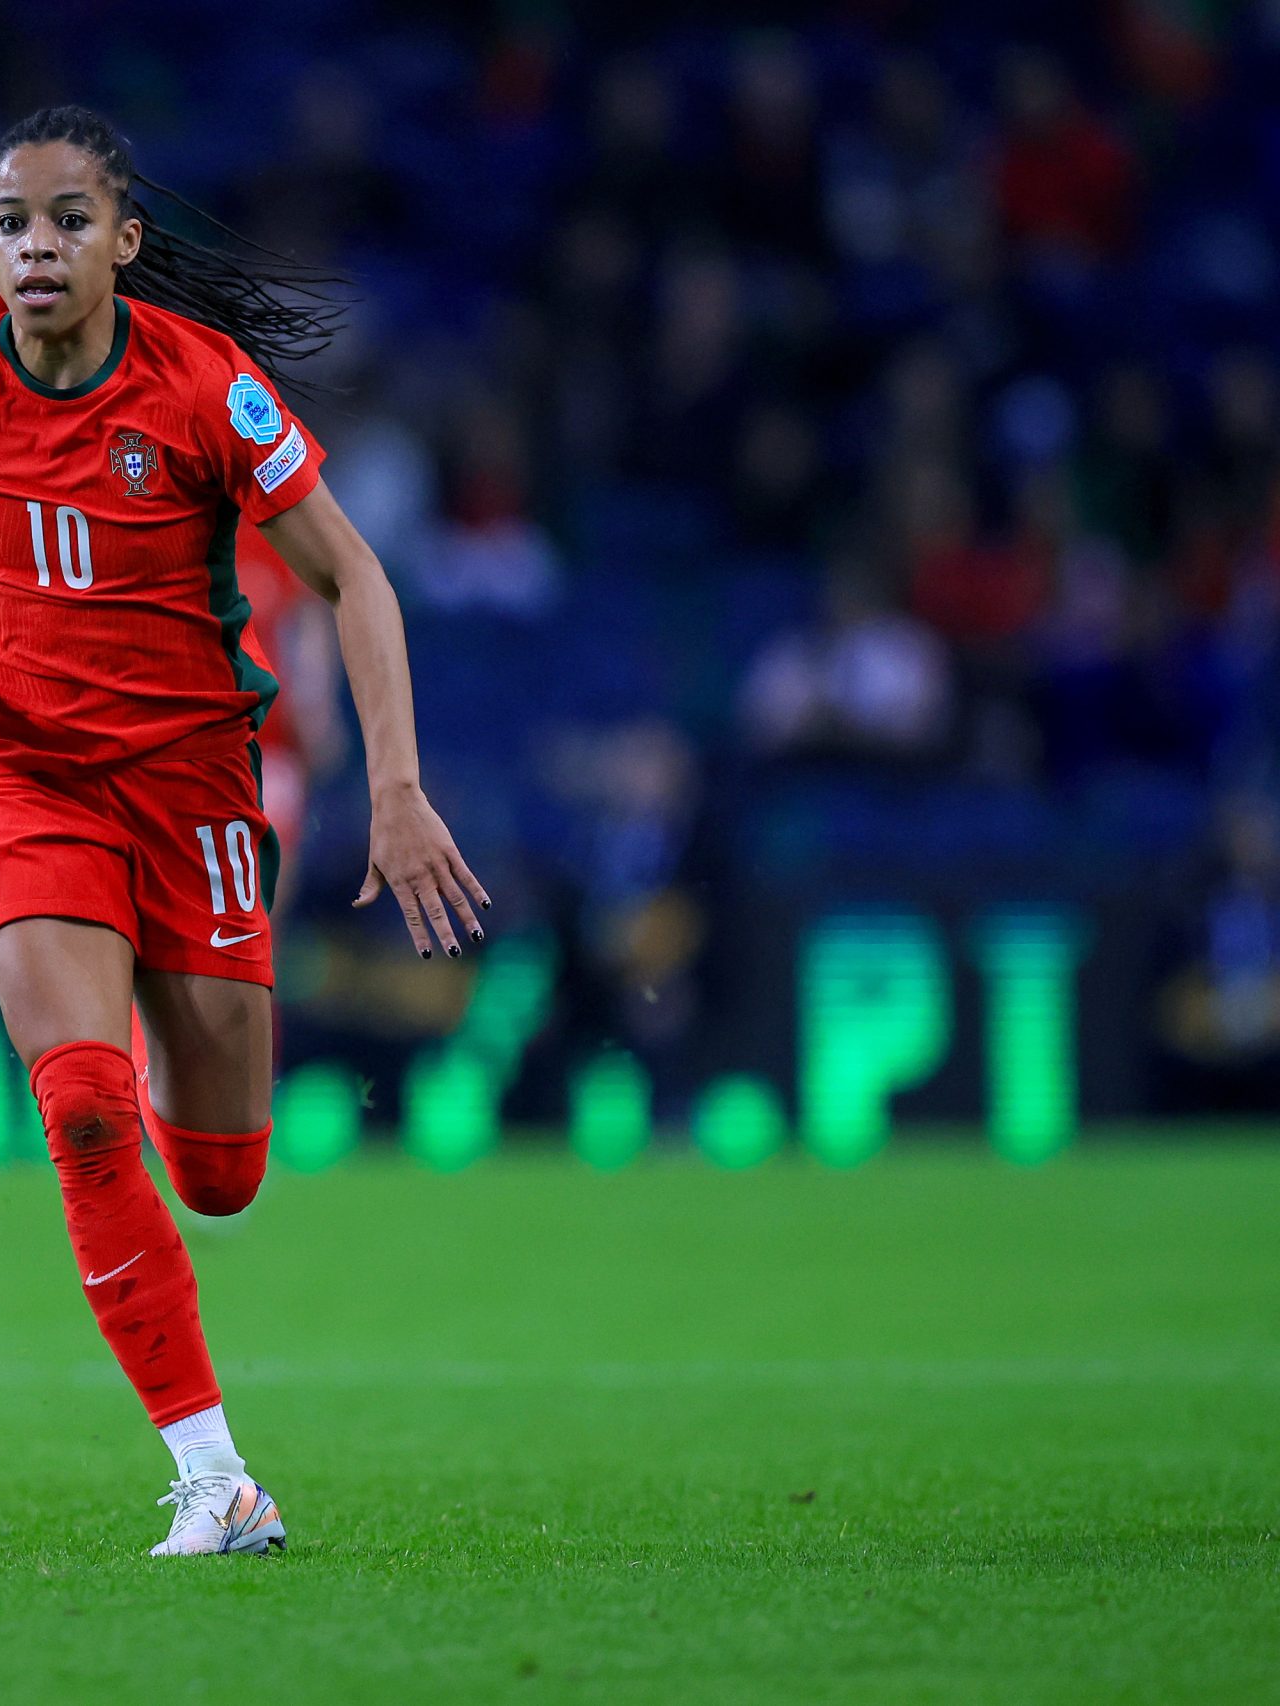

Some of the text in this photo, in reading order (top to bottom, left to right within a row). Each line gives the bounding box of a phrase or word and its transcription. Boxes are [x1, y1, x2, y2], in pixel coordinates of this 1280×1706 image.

[256, 461, 273, 477] UEFA
[260, 433, 305, 486] FOUNDAT
[26, 501, 94, 590] 10
[195, 820, 256, 915] 10
